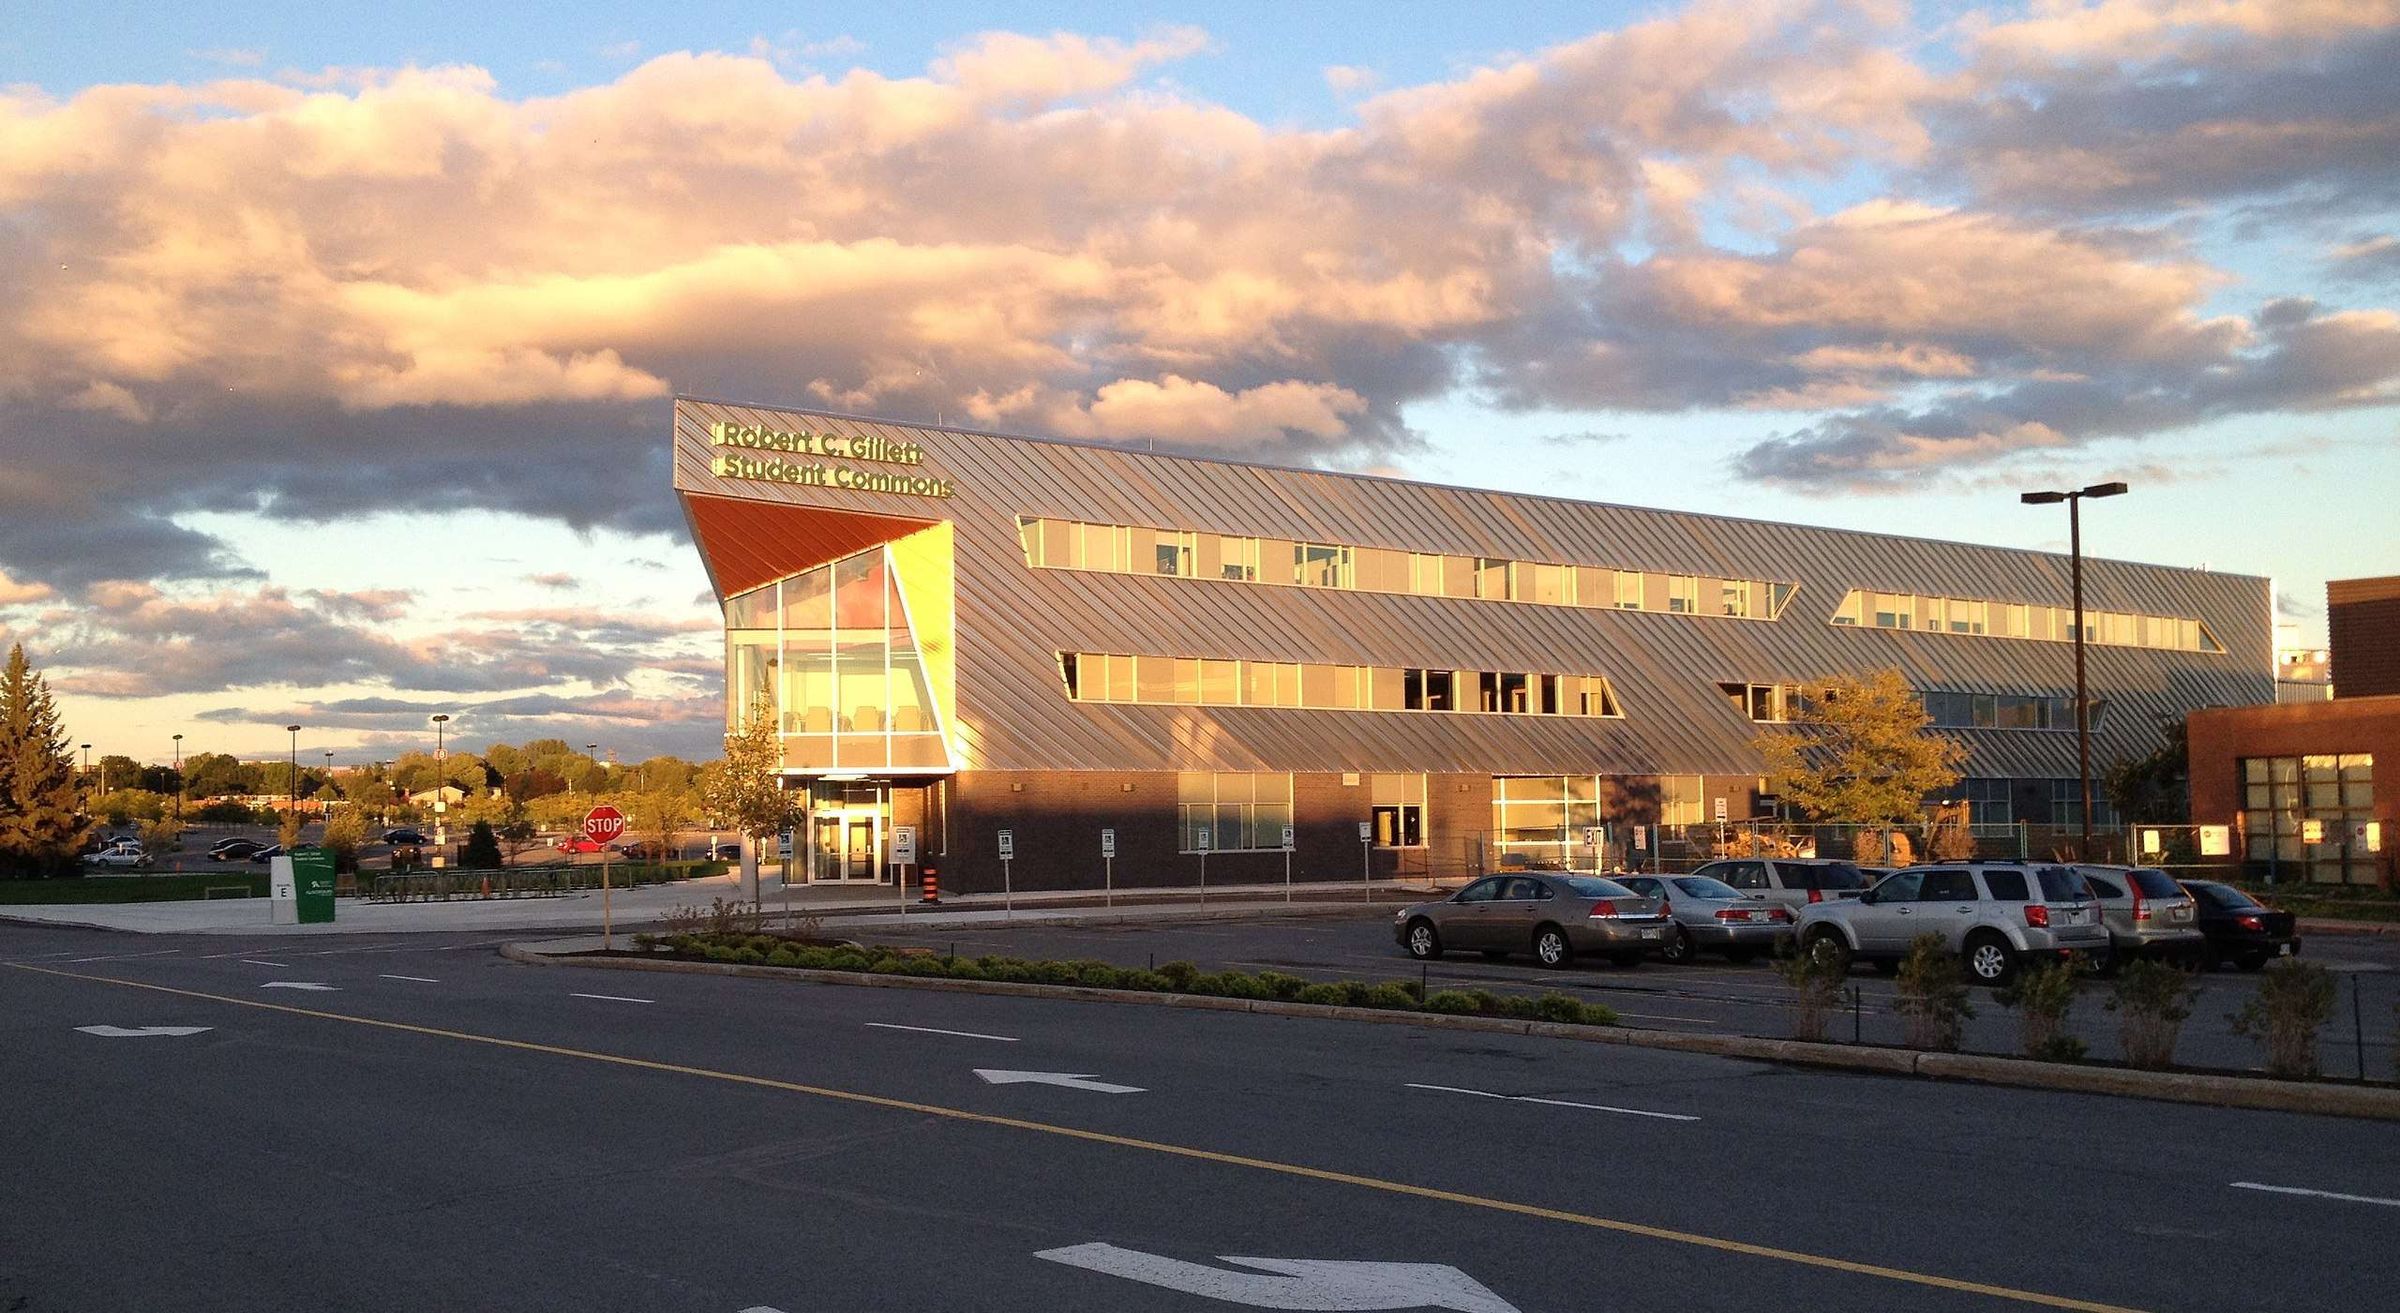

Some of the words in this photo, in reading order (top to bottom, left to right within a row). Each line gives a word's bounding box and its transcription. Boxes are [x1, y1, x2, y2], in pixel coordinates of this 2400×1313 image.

[723, 422, 812, 452] Robert
[821, 432, 844, 457] C.
[850, 436, 922, 463] Gillett
[723, 453, 826, 485] Student
[834, 465, 956, 498] Commons
[587, 817, 622, 833] STOP
[1586, 829, 1602, 845] EXIT
[281, 887, 288, 897] E
